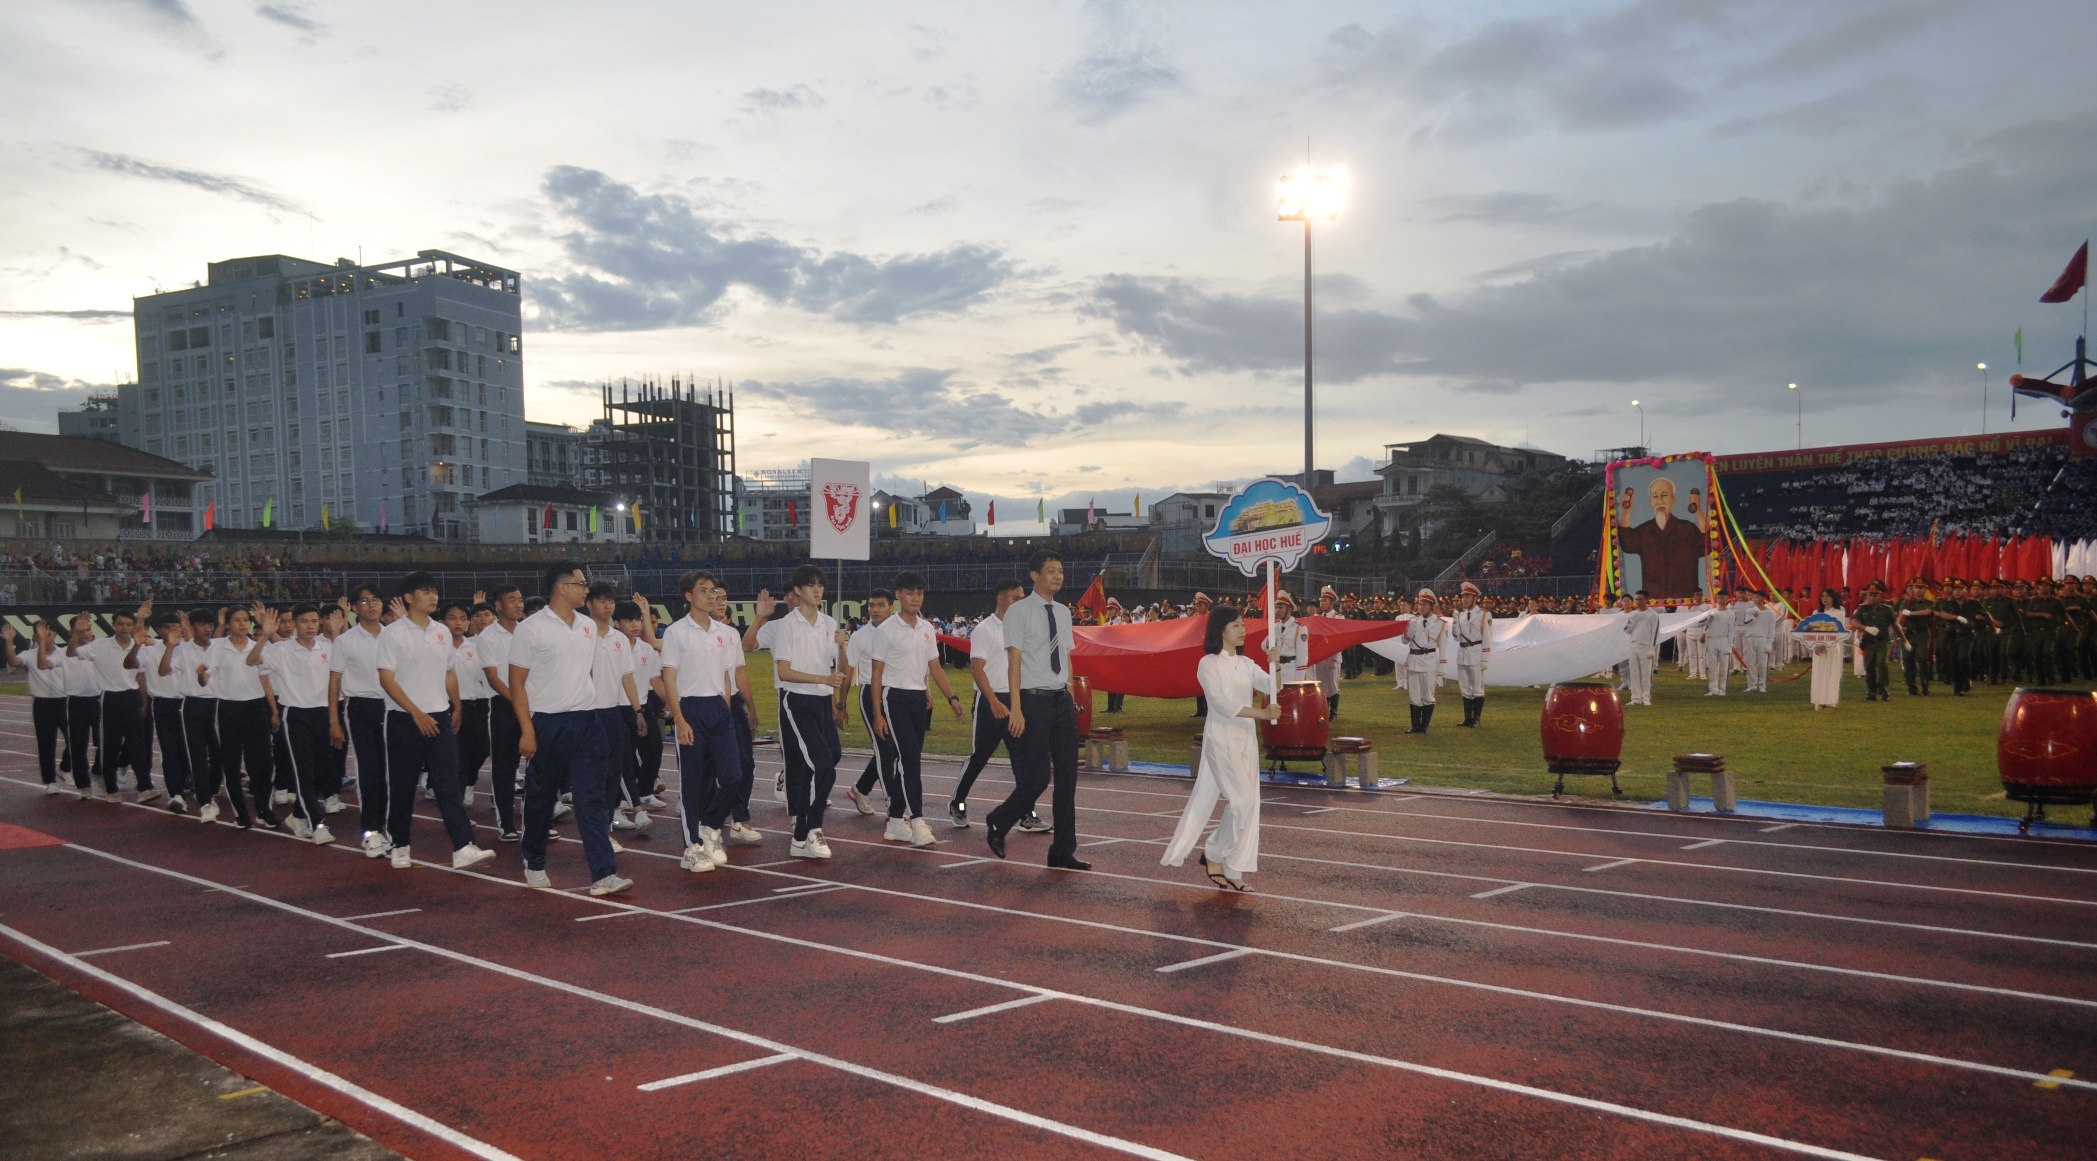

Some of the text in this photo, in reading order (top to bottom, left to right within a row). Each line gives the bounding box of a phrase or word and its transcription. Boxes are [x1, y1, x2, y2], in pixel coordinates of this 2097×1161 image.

[1732, 455, 1774, 472] LUYỆN
[1776, 453, 1813, 468] THÂN
[1233, 541, 1252, 557] ĐẠI
[1254, 537, 1277, 554] HỌC
[1280, 529, 1302, 549] HUẾ
